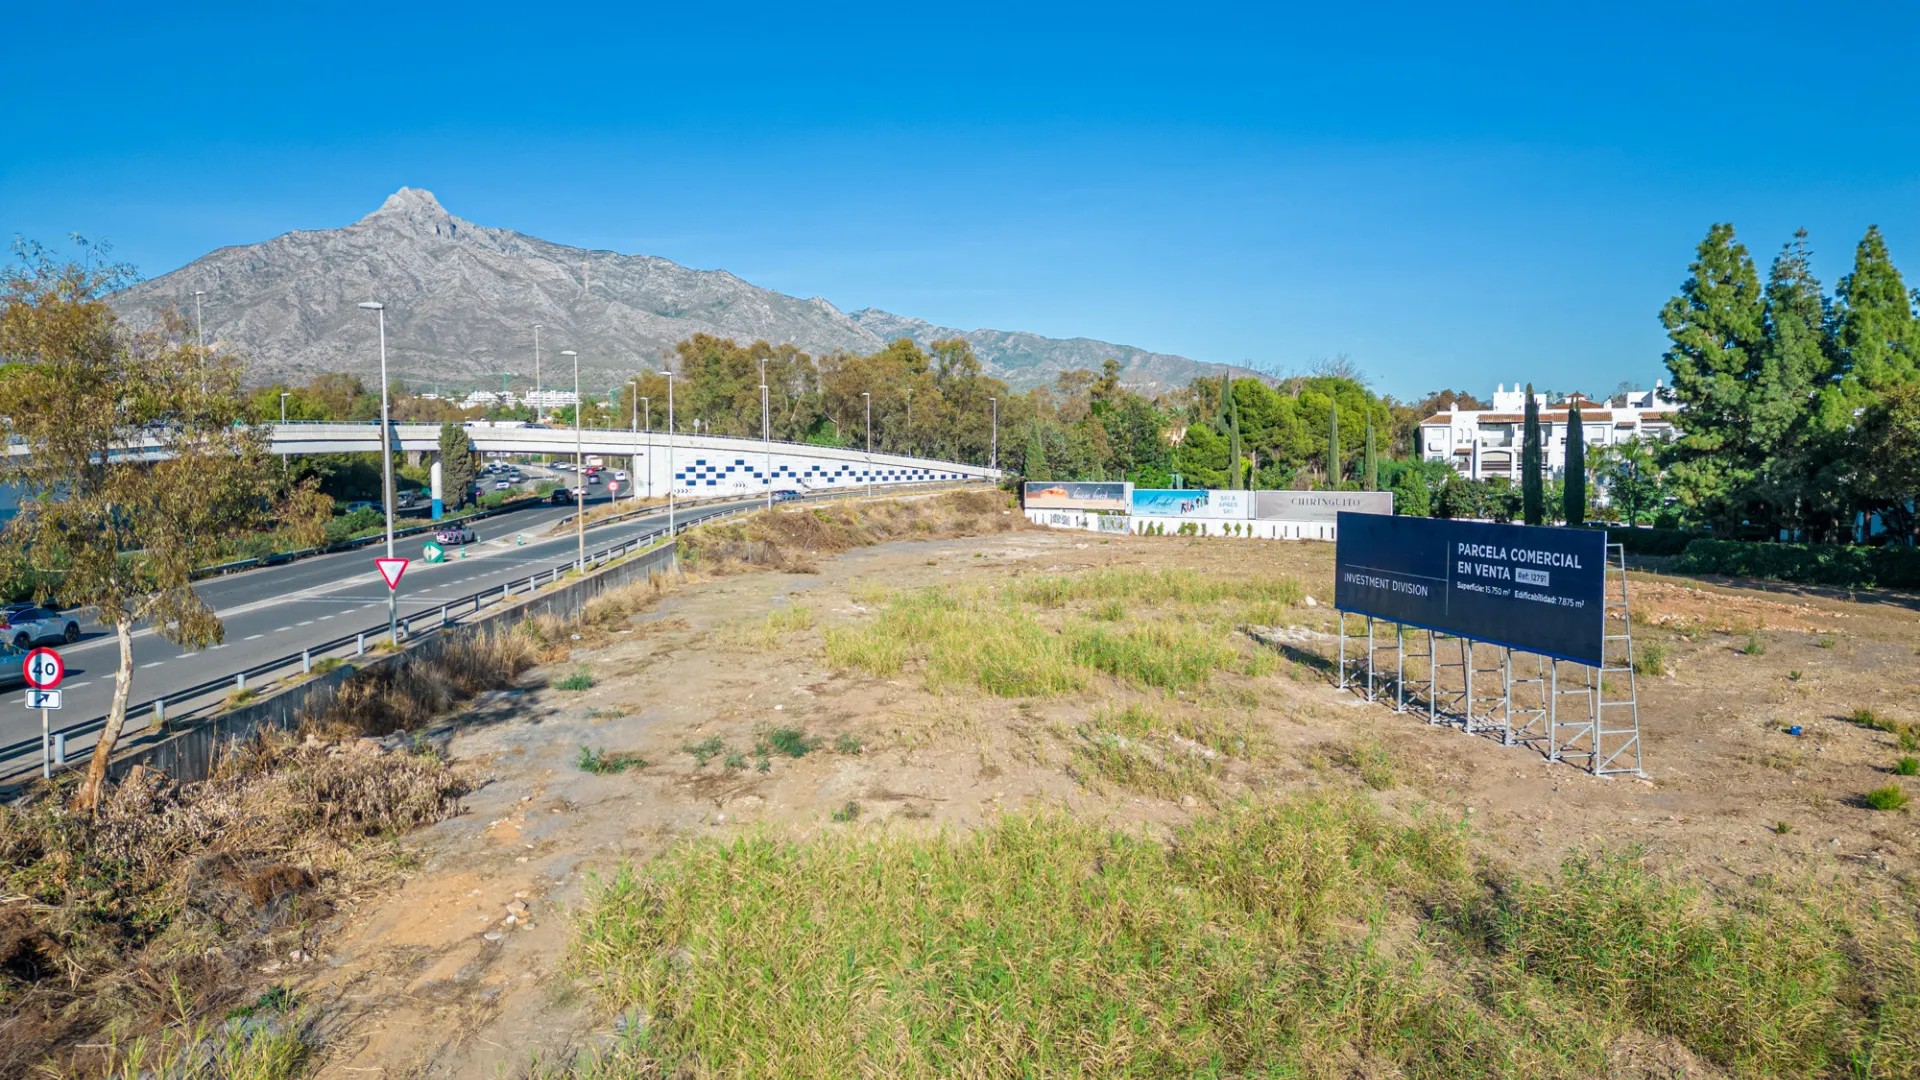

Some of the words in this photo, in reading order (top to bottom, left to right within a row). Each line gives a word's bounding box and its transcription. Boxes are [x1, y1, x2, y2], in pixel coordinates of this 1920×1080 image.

[1291, 497, 1361, 507] CHIRINGUITO
[1458, 542, 1507, 560] PARCELA
[1510, 548, 1582, 569] COMERCIAL
[1457, 561, 1472, 575] EN
[1474, 563, 1511, 580] VENTA
[1344, 572, 1390, 590] INVESTMENT
[1392, 580, 1428, 596] DIVISION
[1457, 581, 1485, 593] Superficie:
[1485, 585, 1502, 595] 15.750
[1514, 590, 1557, 604] Edificabilidad:
[1558, 596, 1575, 607] 7.875
[32, 662, 55, 676] 40
